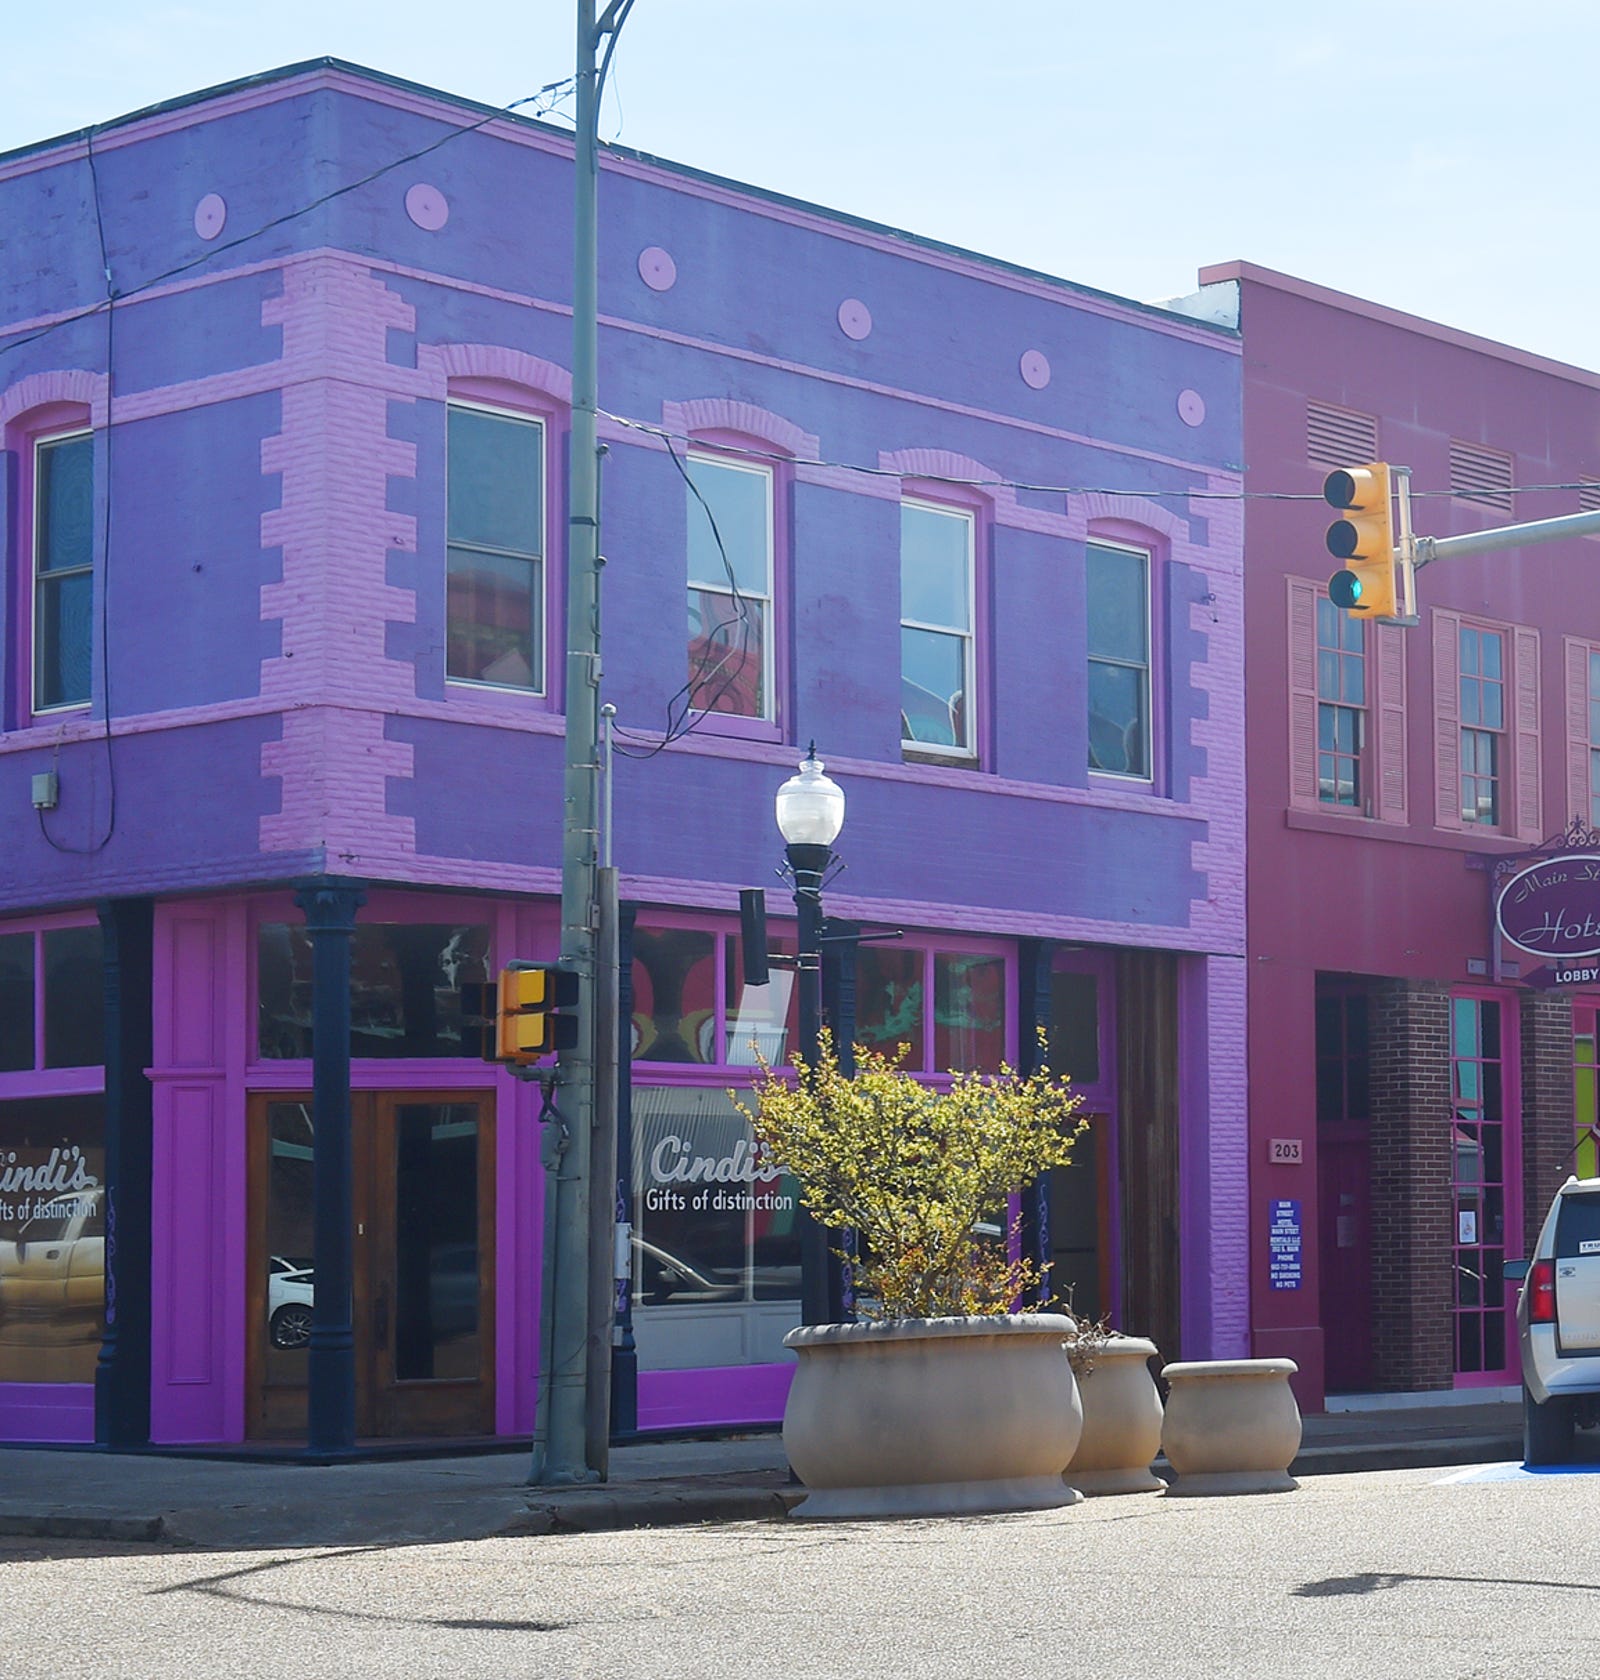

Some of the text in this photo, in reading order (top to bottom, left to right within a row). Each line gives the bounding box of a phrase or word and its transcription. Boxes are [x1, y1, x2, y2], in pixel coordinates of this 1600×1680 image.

[1515, 872, 1568, 903] Main
[1556, 968, 1600, 983] LOBBY
[650, 1135, 791, 1183] Cindi's
[1275, 1143, 1299, 1158] 203
[0, 1146, 98, 1192] indi's
[17, 1197, 30, 1220] of
[33, 1196, 97, 1220] distinction
[646, 1188, 792, 1211] Gifts of distinction
